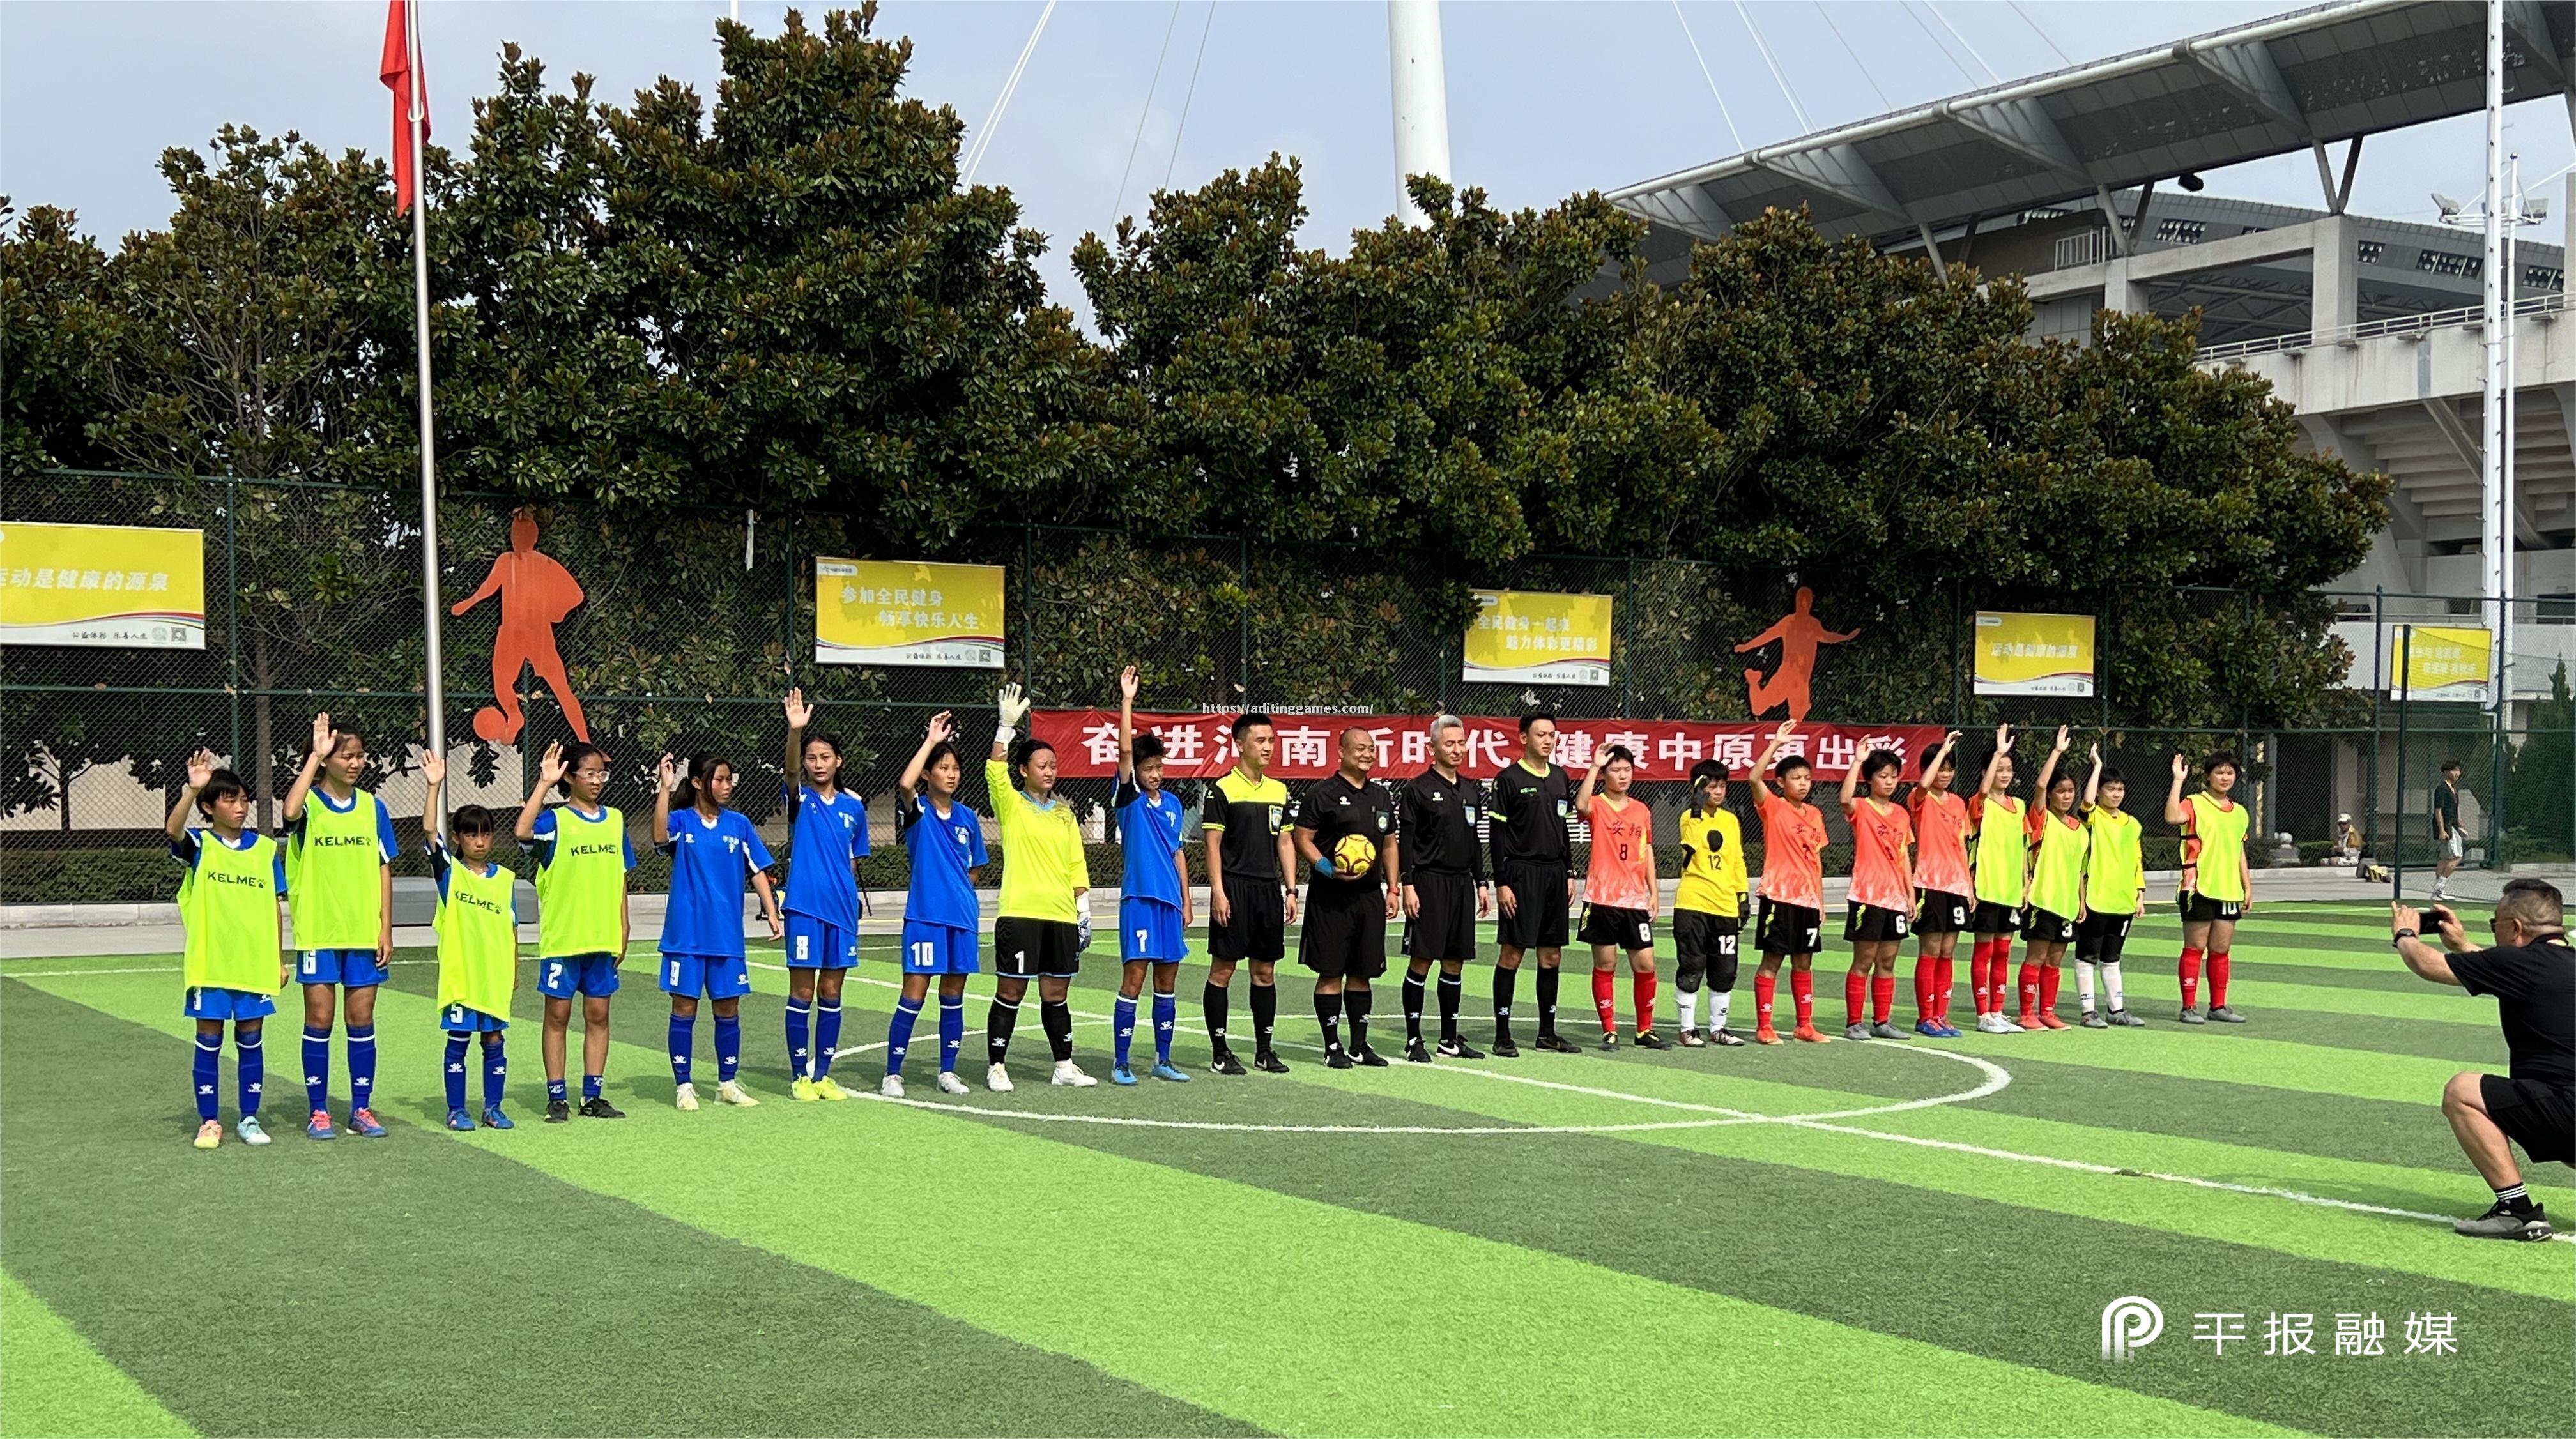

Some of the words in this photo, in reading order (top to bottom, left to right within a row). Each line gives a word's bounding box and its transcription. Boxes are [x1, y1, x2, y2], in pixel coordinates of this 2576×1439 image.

[841, 585, 944, 607] 参加全民健身
[878, 609, 980, 630] 畅享快乐人生
[314, 835, 365, 846] KELME
[570, 844, 617, 857] KELME
[1619, 843, 1628, 860] 8
[1708, 854, 1722, 871] 12
[208, 871, 256, 887] KELME
[1895, 914, 1906, 934] 6
[1953, 906, 1966, 925] 9
[2009, 908, 2021, 925] 4
[1639, 922, 1652, 942] 8
[1806, 927, 1818, 947] 7
[2061, 920, 2073, 938] 3
[796, 936, 809, 960] 8
[1136, 929, 1147, 953] 7
[1718, 934, 1736, 955] 12
[910, 941, 934, 966] 10
[1014, 950, 1025, 974] 1
[548, 962, 563, 989] 2
[450, 1003, 463, 1024] 5
